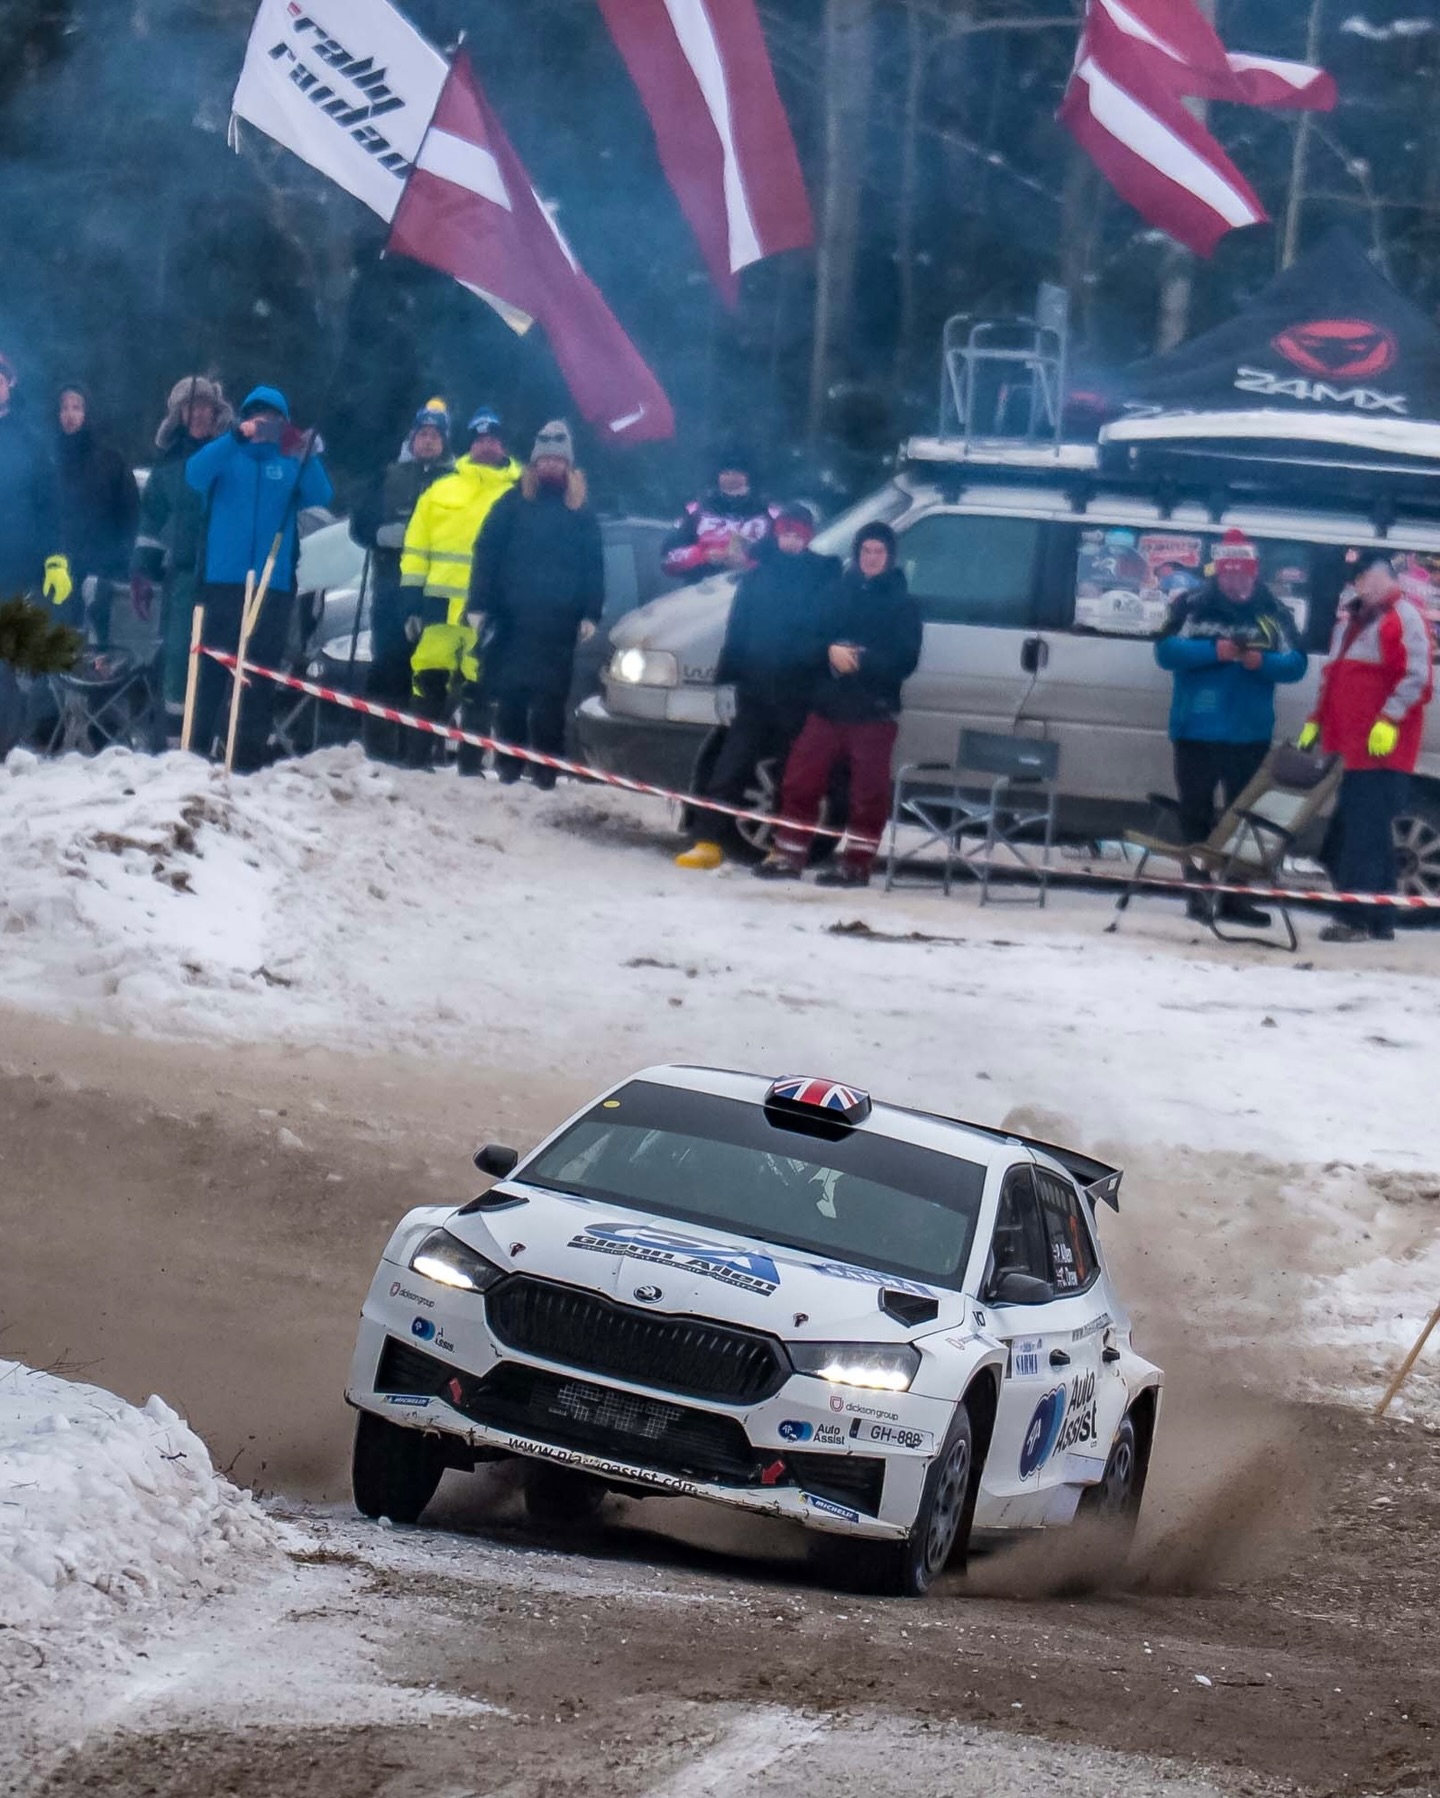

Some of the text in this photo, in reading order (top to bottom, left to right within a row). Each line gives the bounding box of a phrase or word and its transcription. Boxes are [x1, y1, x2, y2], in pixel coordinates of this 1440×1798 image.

[293, 17, 406, 119] rally
[1234, 367, 1408, 414] 24MX
[572, 1235, 778, 1292] Glenn Allen
[1066, 1368, 1095, 1416] Auto
[812, 1433, 845, 1446] Assist
[817, 1423, 841, 1436] Auto
[1051, 1400, 1097, 1457] Assist
